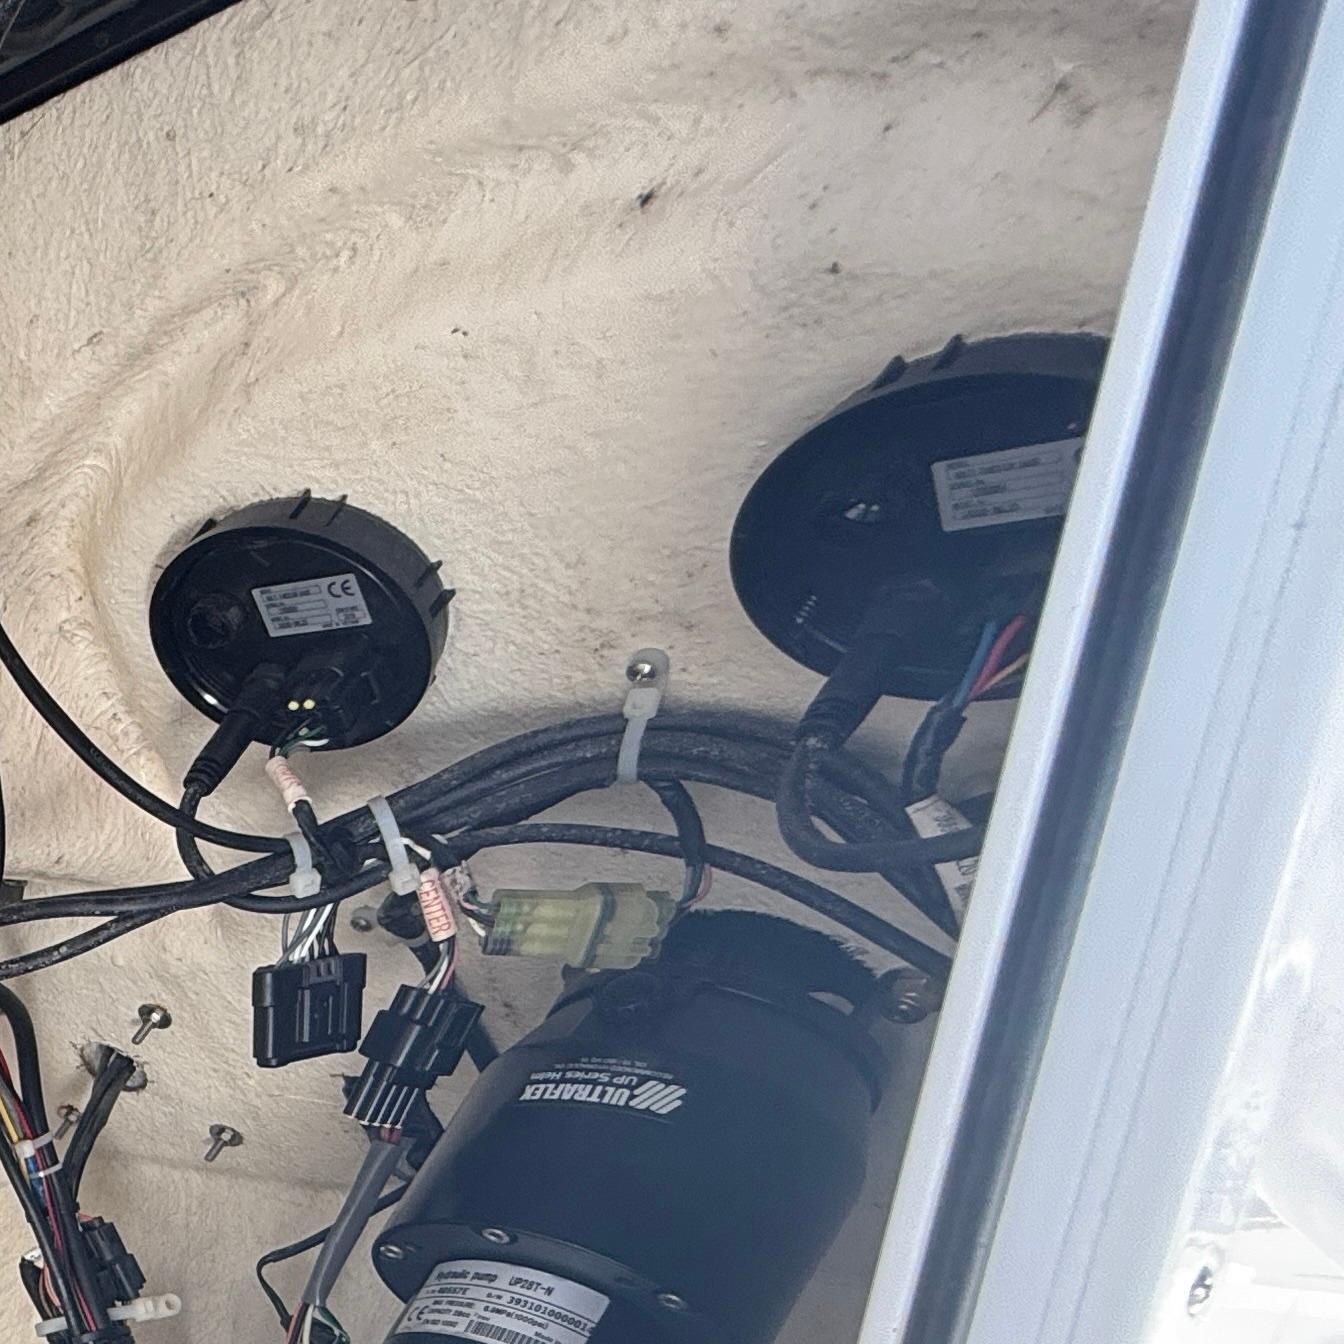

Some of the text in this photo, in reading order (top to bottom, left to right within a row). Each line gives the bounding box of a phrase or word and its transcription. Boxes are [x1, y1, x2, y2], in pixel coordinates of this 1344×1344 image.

[419, 879, 452, 937] CENTER
[530, 1071, 638, 1086] UP Series Helm
[519, 1083, 631, 1106] ULTRAFLEX
[470, 1271, 499, 1284] pump
[509, 1276, 554, 1297] UP28T-N
